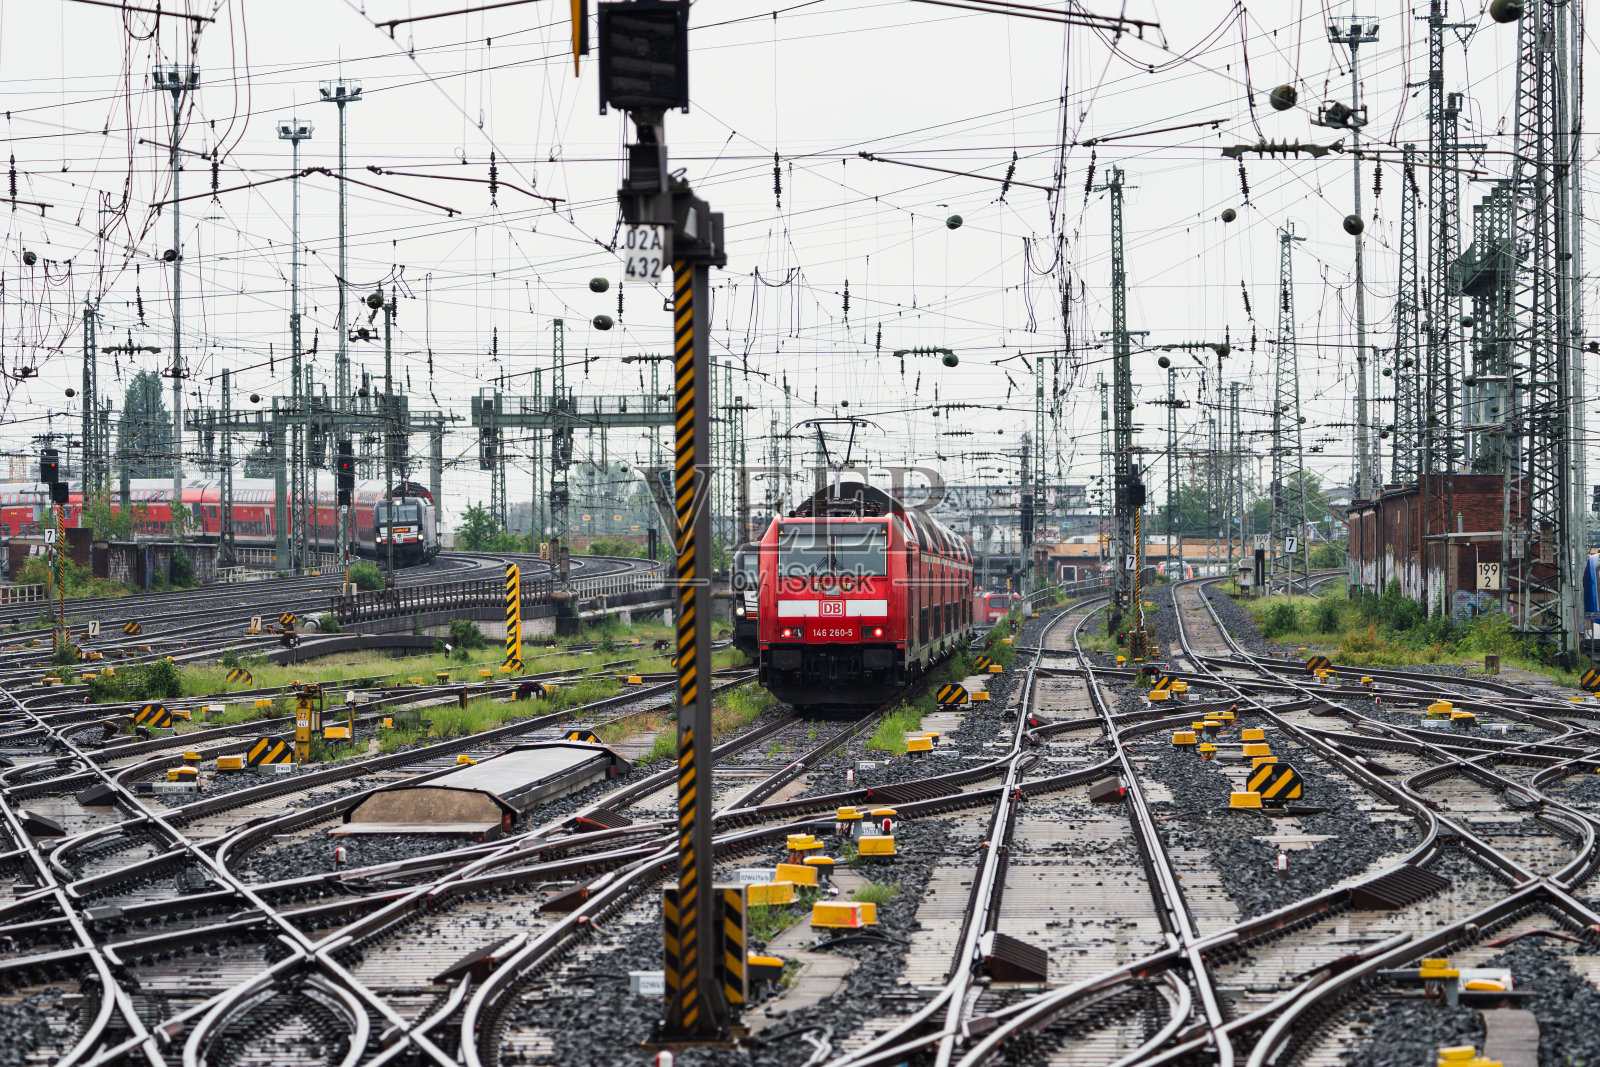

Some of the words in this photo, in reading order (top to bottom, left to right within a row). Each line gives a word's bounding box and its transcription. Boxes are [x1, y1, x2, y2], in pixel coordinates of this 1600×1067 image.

[627, 230, 662, 249] 02A
[625, 256, 660, 277] 432
[47, 530, 53, 541] 7
[1288, 538, 1295, 551] 7
[1129, 556, 1135, 568] 7
[1479, 564, 1498, 575] 199
[1484, 576, 1491, 587] 2
[823, 602, 842, 614] DB
[91, 622, 97, 633] 7
[253, 618, 259, 628] 7
[813, 629, 827, 637] 146
[830, 629, 853, 637] 260-5
